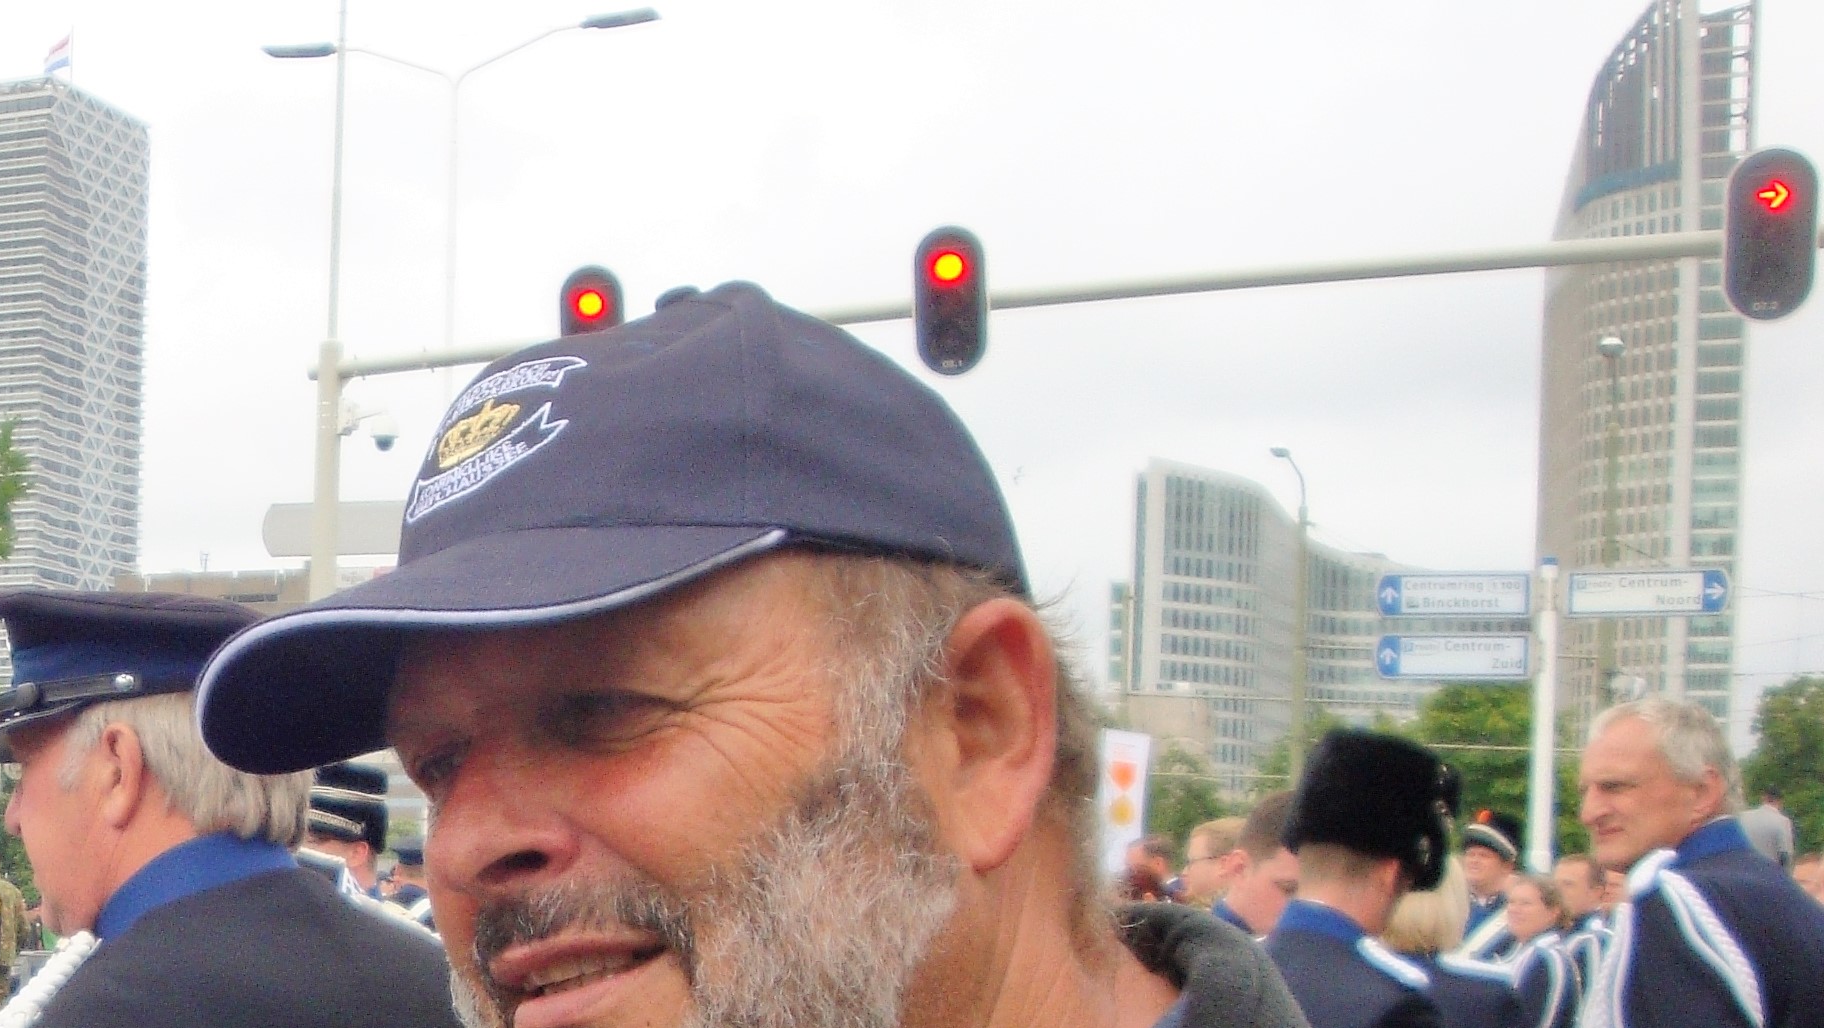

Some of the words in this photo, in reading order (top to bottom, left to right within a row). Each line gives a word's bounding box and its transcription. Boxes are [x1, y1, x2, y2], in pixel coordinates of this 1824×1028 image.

[1404, 580, 1485, 593] Centrumring
[1422, 597, 1500, 609] Binckhorst
[1656, 594, 1702, 605] Noord
[1491, 658, 1522, 669] Zuid
